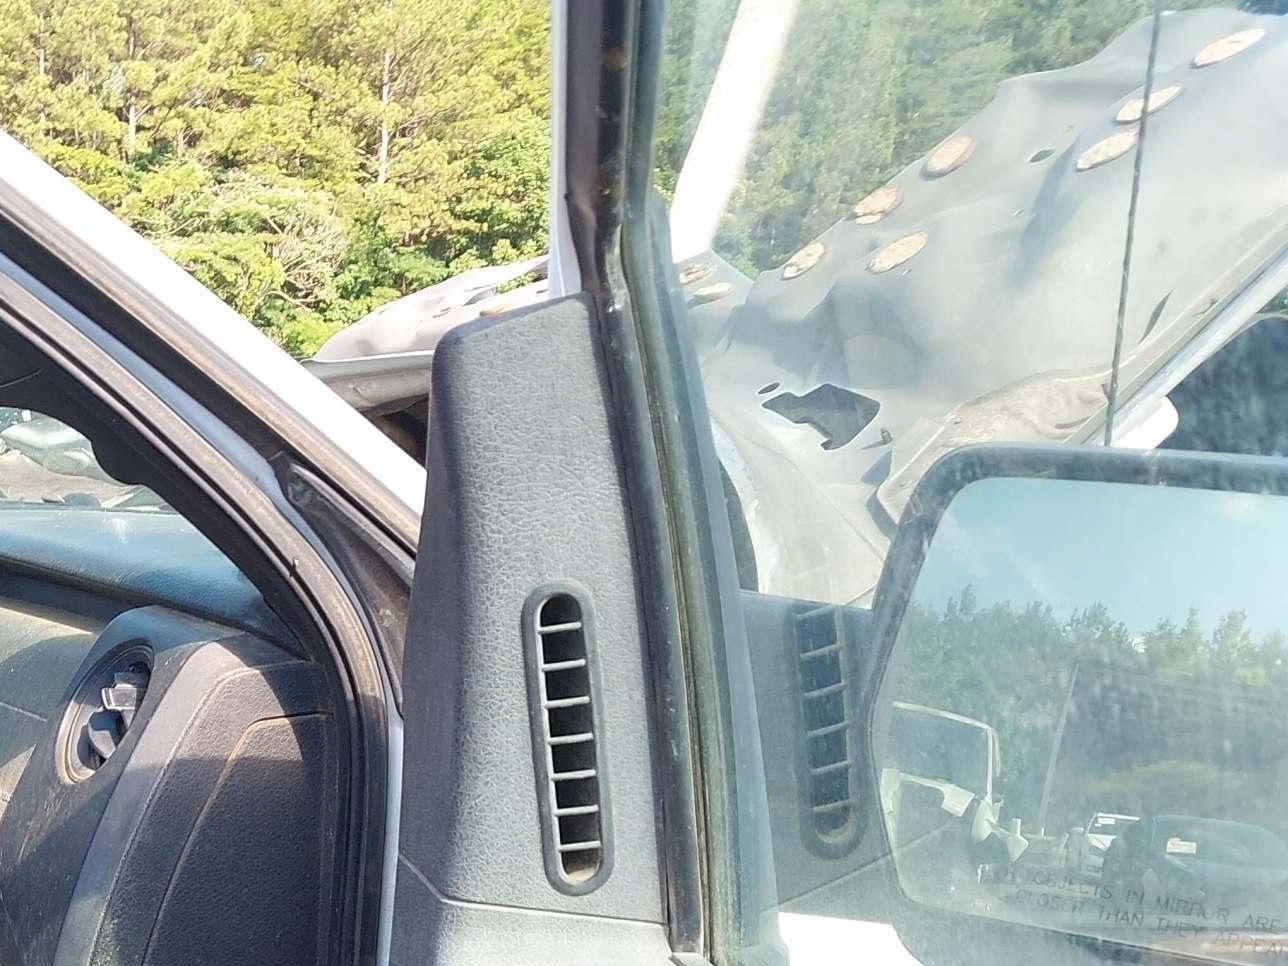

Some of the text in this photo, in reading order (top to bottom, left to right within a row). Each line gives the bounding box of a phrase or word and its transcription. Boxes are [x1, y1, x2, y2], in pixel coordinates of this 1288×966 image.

[1015, 887, 1086, 914] CLOSER
[1097, 905, 1146, 930] THAN
[1156, 916, 1205, 940] THEY
[1032, 867, 1282, 935] OBJECTS IN MIRROR ARE
